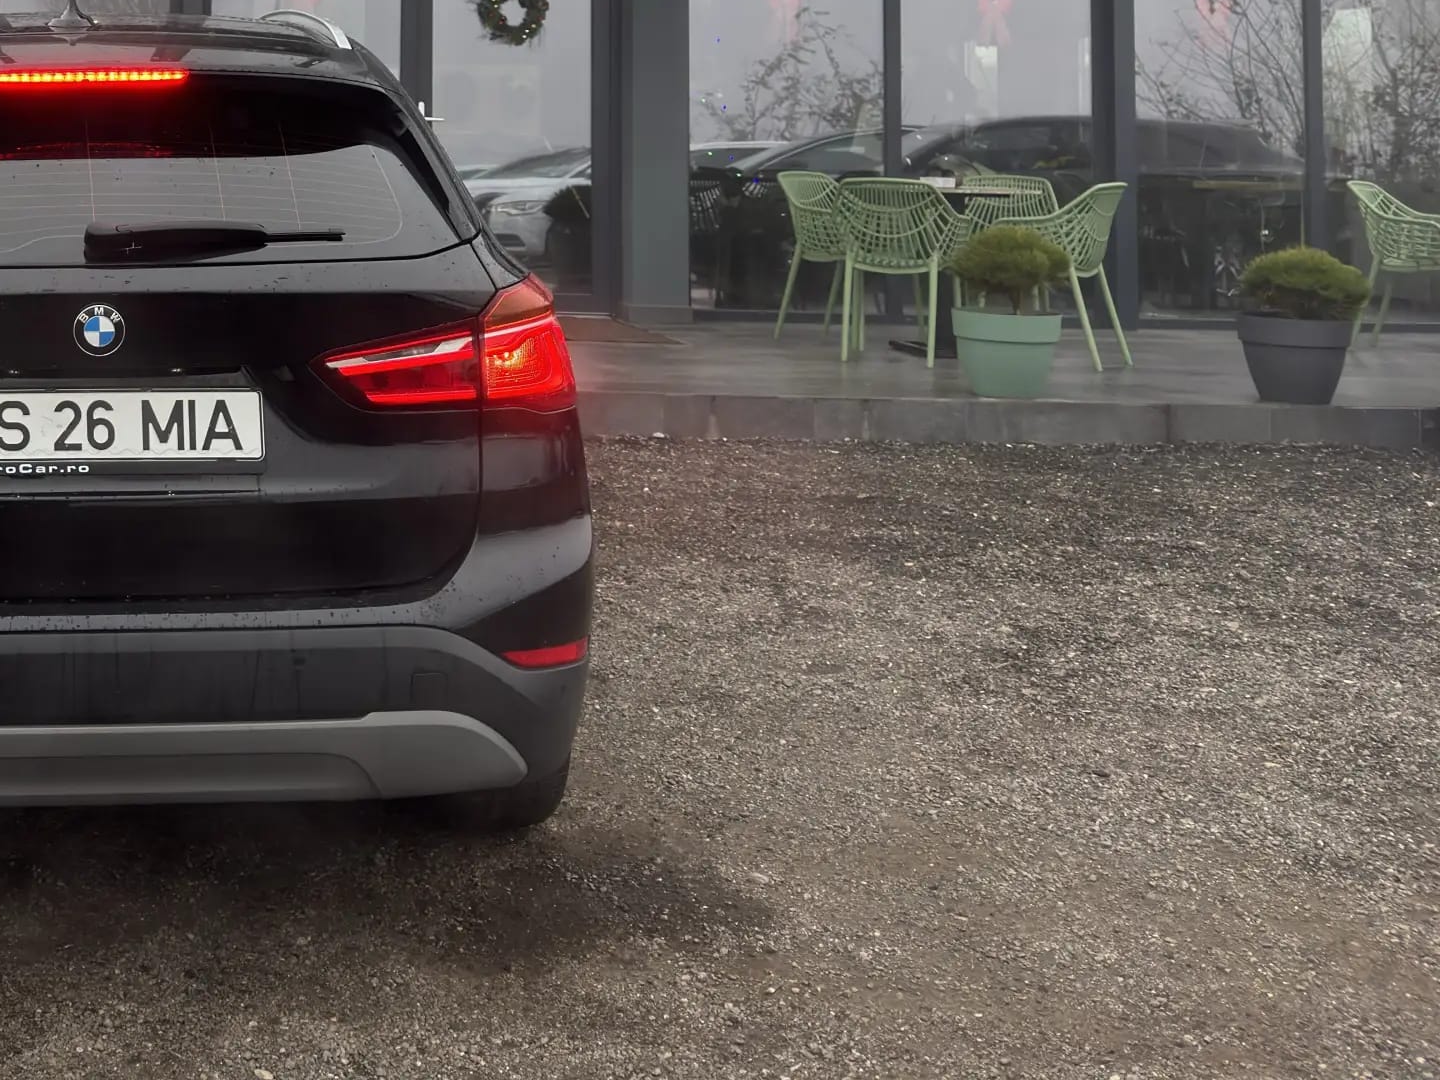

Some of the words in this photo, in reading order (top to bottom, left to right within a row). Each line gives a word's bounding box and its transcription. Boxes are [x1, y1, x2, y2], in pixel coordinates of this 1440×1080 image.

[79, 306, 121, 324] BMW
[54, 400, 115, 451] 26
[141, 399, 243, 451] MIA
